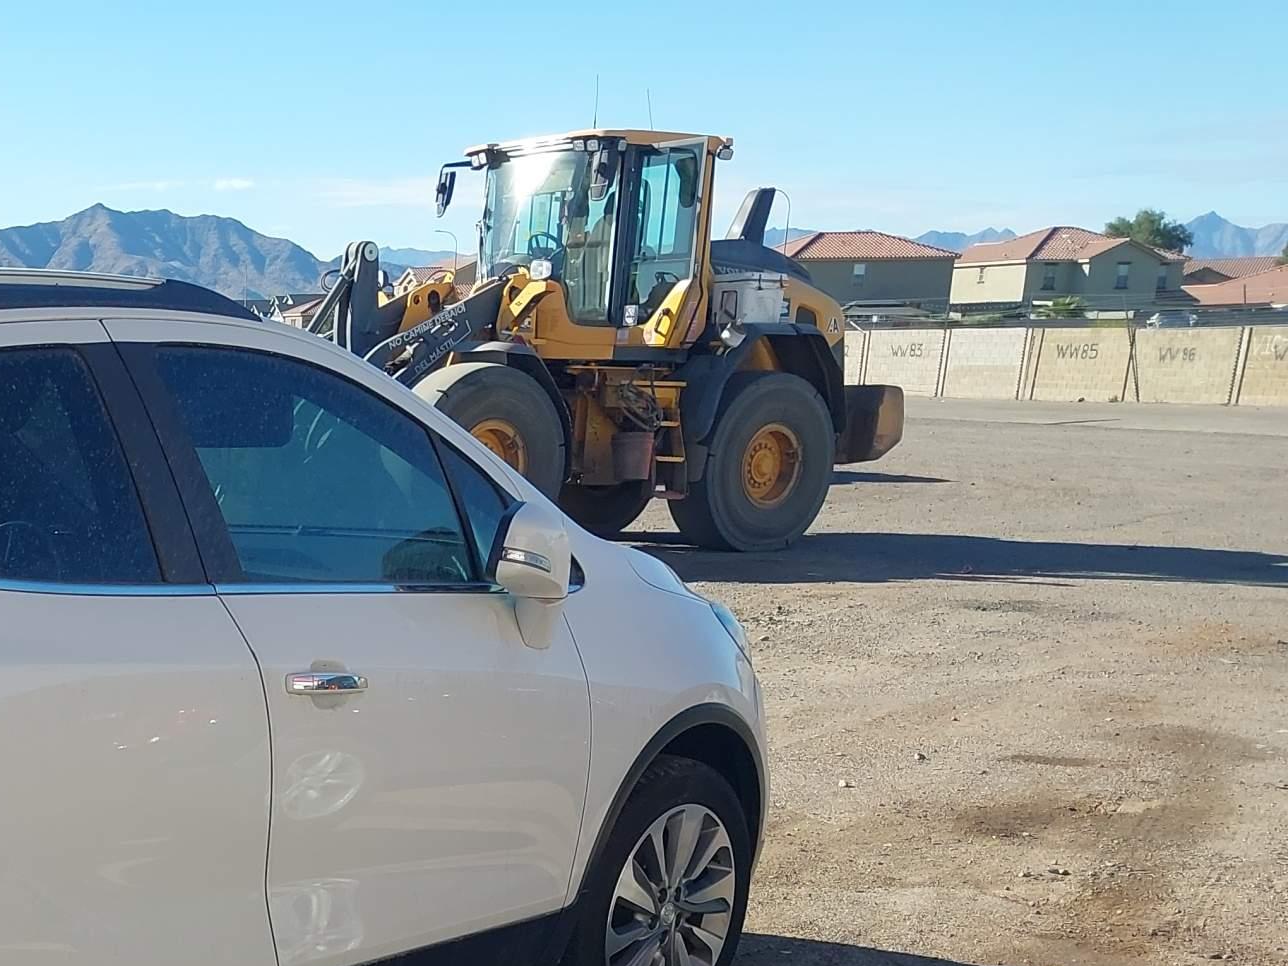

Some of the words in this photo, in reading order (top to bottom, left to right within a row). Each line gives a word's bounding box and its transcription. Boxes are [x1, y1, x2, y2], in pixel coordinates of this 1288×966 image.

[388, 337, 402, 351] NO
[403, 320, 434, 342] CAMINE
[434, 305, 464, 325] DEBAJO
[1056, 343, 1099, 360] WW85
[415, 360, 430, 373] DEL
